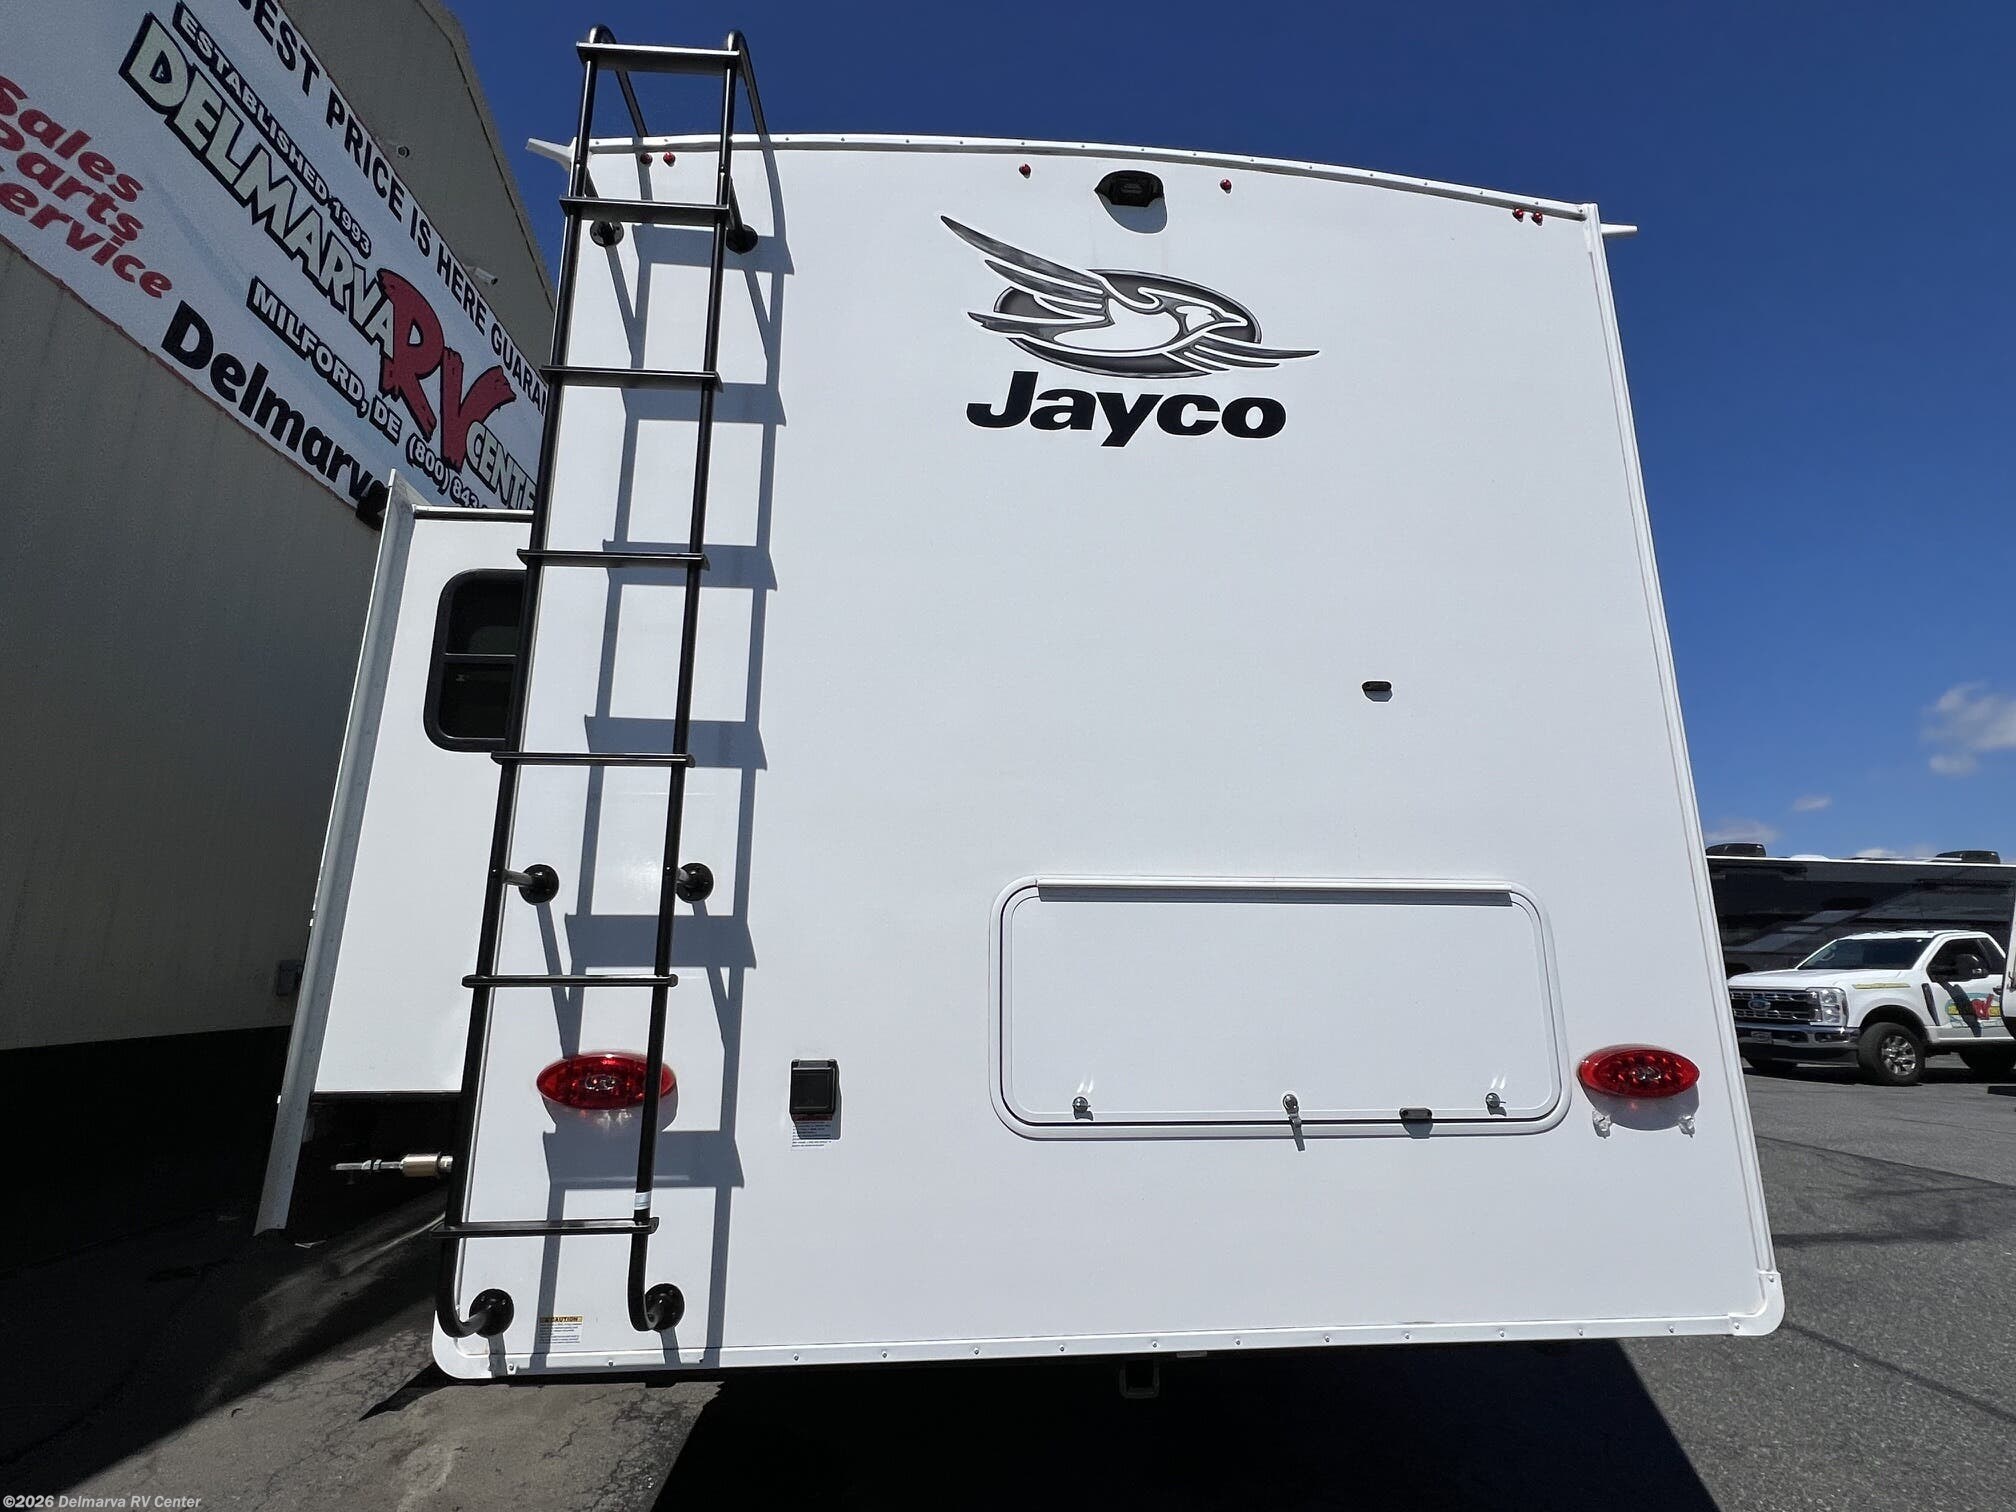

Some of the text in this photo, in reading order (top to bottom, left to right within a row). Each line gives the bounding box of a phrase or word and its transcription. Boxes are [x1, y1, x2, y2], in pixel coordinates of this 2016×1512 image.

[0, 166, 172, 298] ervice
[119, 12, 396, 358] DELMARVA
[377, 268, 517, 473] RV
[173, 1, 371, 259] ESTABLISHED 1993
[238, 0, 320, 96] EST
[326, 88, 405, 223] PRICE
[410, 205, 431, 257] IS
[436, 241, 487, 337] HERE
[246, 276, 369, 418] MILFORD,
[369, 395, 403, 446] DE
[406, 433, 450, 495] (800)
[966, 371, 1287, 447] Jayco
